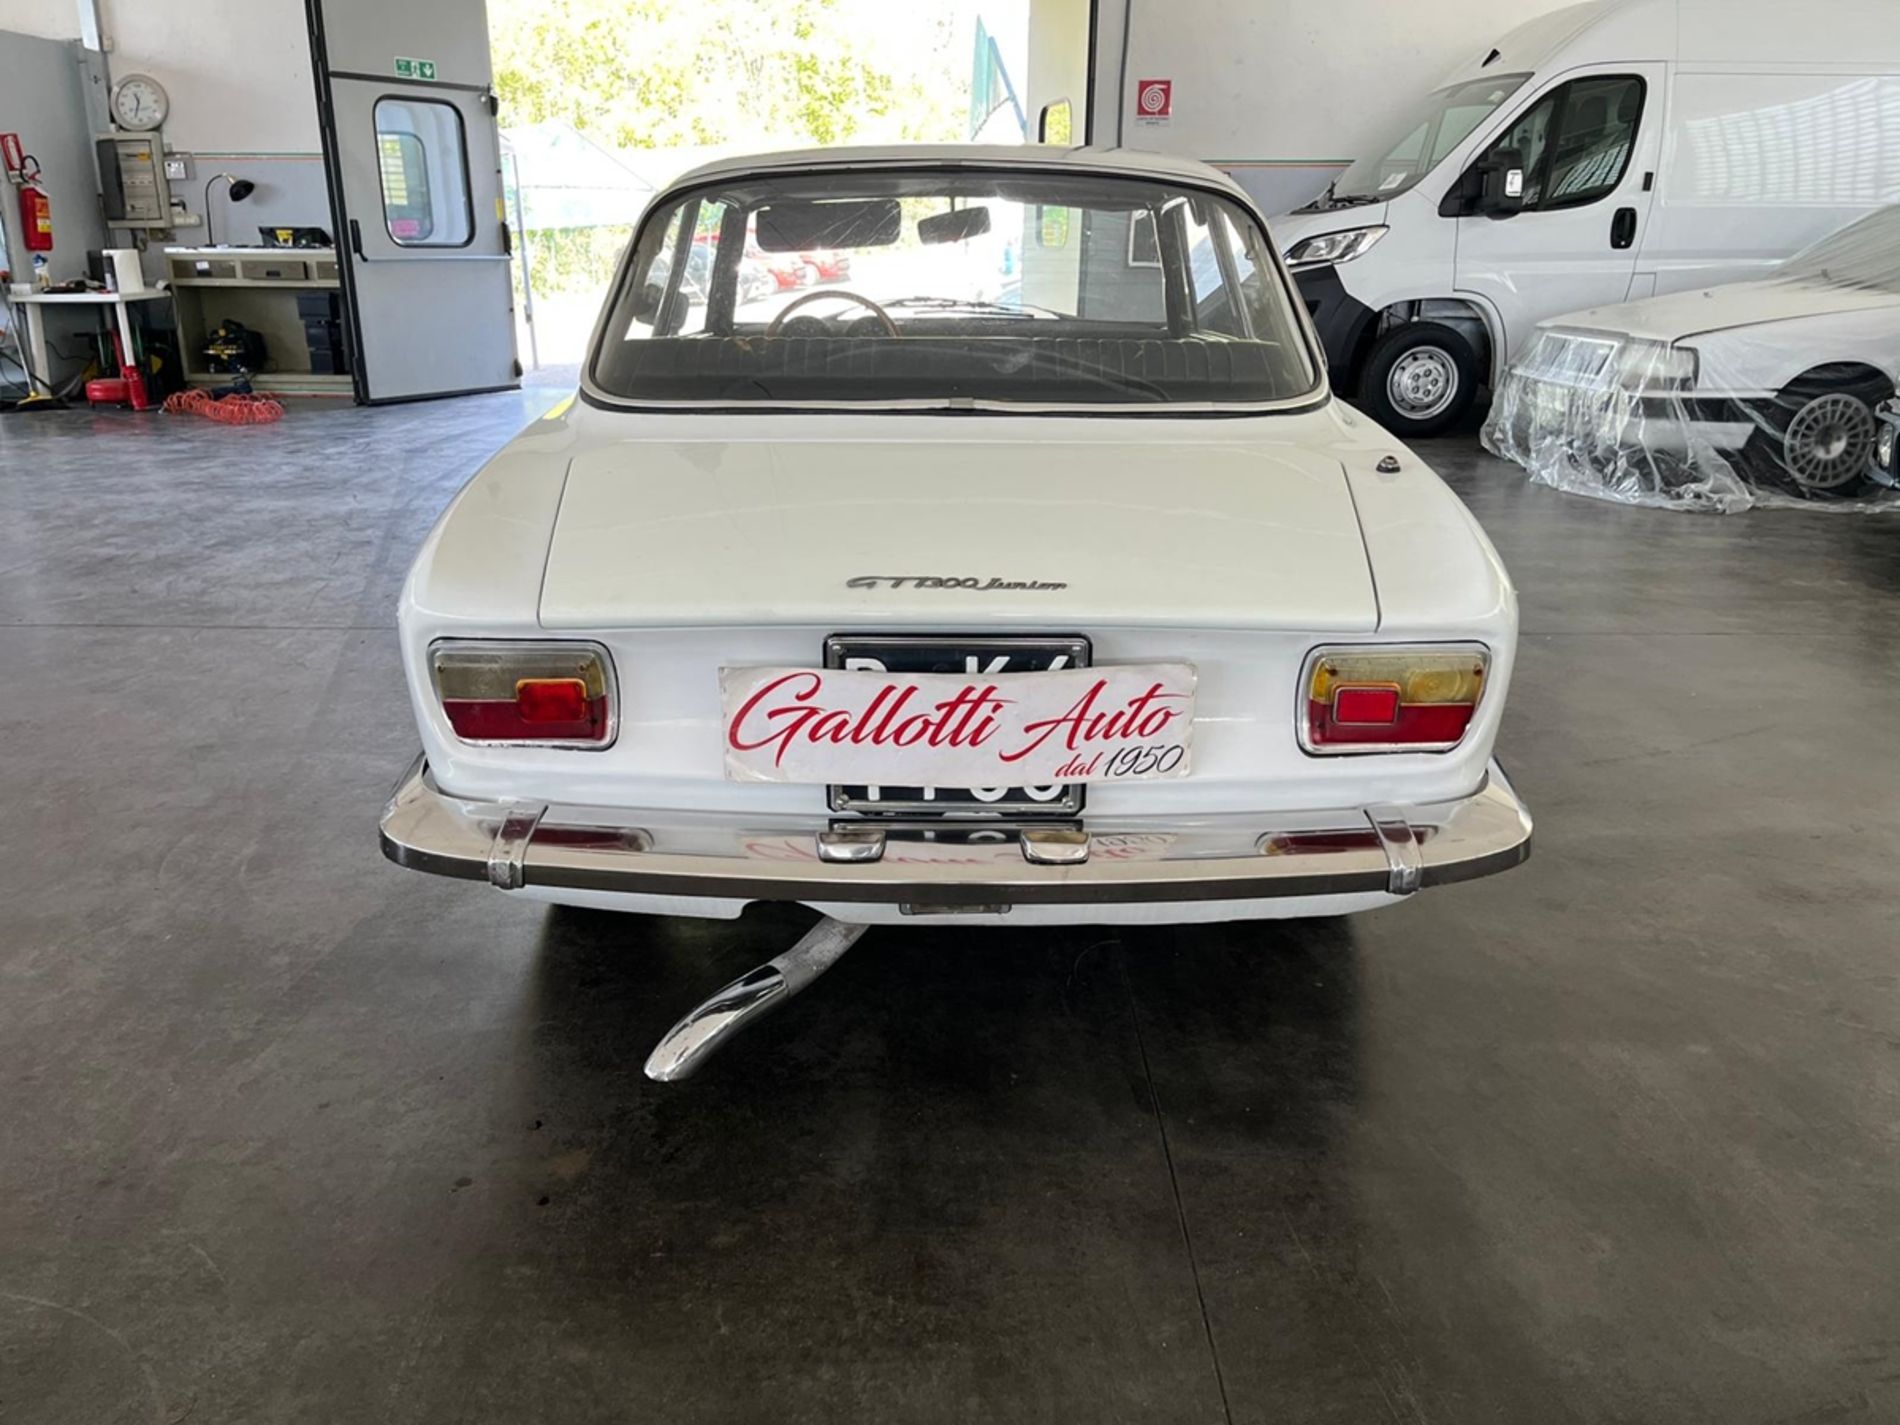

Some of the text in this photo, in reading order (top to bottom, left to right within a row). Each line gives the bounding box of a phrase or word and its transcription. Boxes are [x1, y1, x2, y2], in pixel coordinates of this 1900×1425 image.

[976, 577, 1068, 591] Junior
[727, 671, 1191, 768] Gallotti Auto
[1055, 744, 1185, 777] dal 1950
